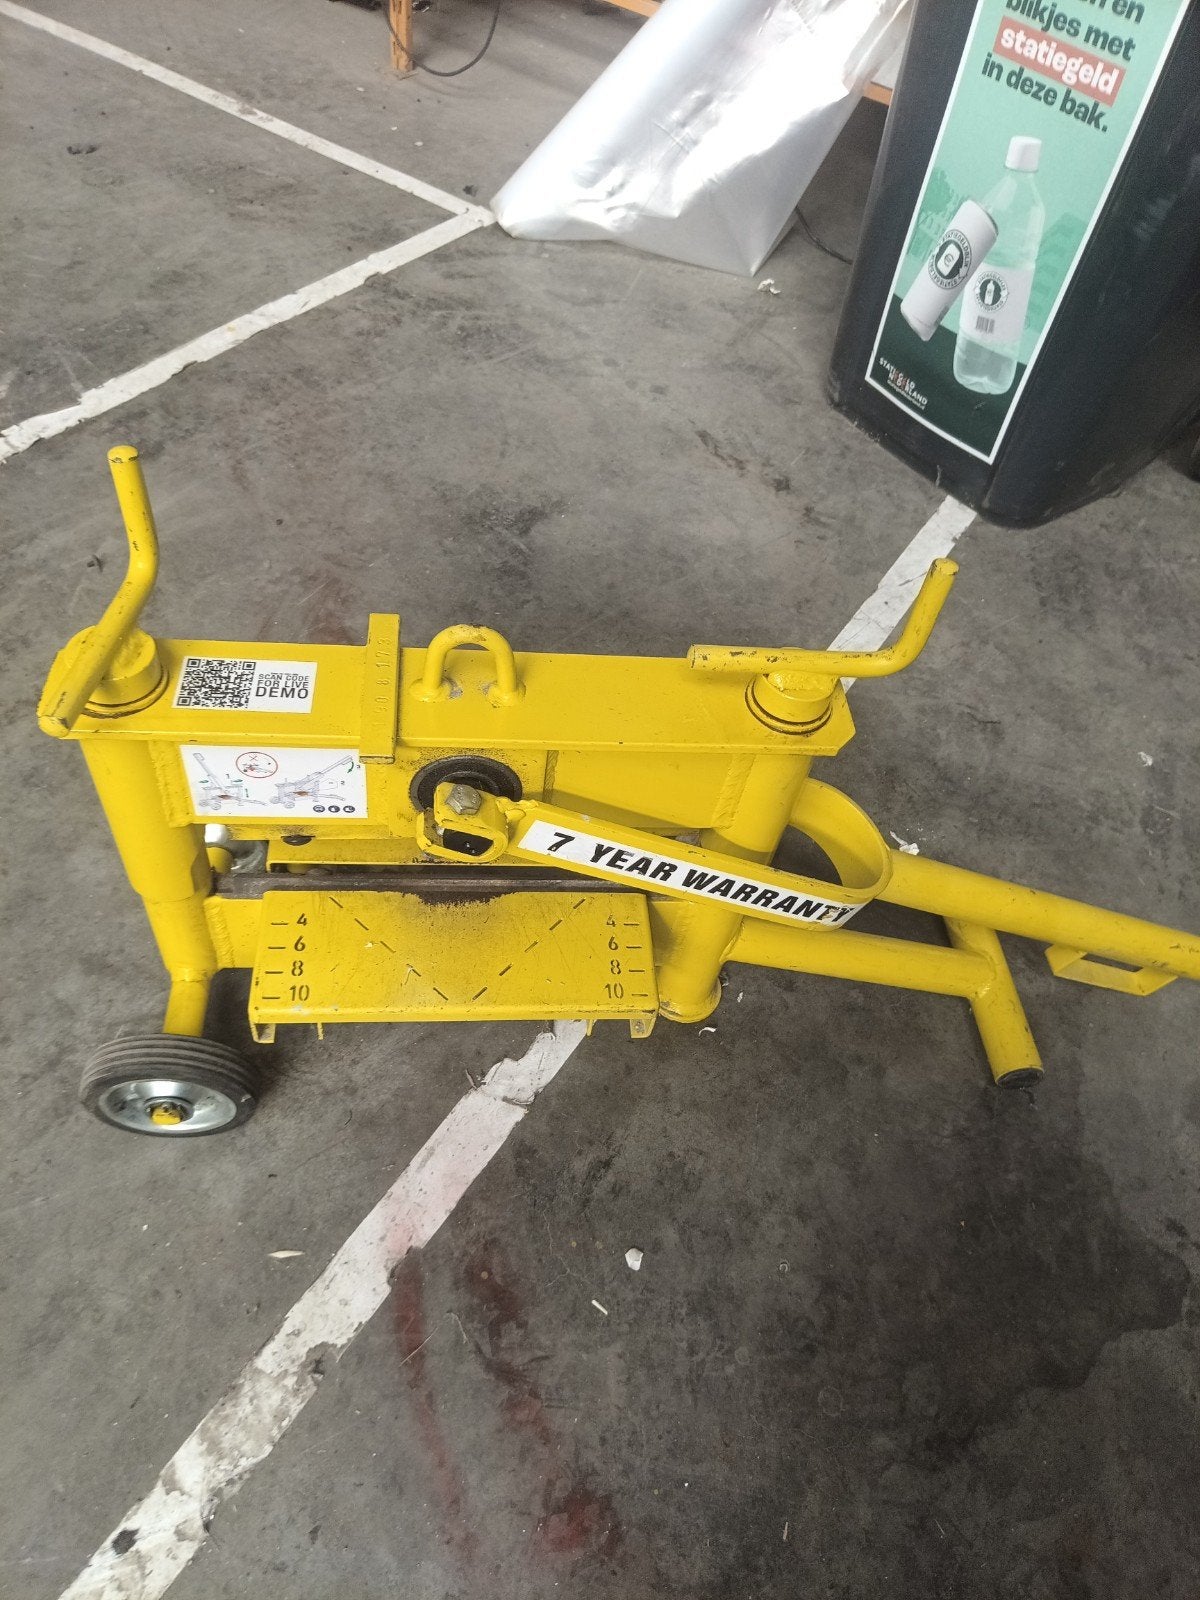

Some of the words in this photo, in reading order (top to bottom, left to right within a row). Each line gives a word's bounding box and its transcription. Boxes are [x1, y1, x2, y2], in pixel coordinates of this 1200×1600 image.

[1111, 0, 1146, 24] en
[1005, 0, 1082, 37] blikjes
[1084, 24, 1136, 62] met
[1000, 27, 1120, 96] statiegeld
[981, 52, 1004, 82] in
[1006, 66, 1058, 106] deze
[1059, 88, 1109, 133] bak.
[255, 686, 309, 699] DEMO
[547, 832, 576, 852] 7
[590, 843, 678, 881] YEAR
[682, 868, 854, 922] WARRANTY
[296, 913, 308, 926] 4
[606, 914, 617, 927] 4
[294, 935, 306, 952] 6
[608, 936, 619, 951] 6
[291, 960, 304, 976] 8
[610, 959, 622, 975] 8
[289, 985, 310, 1001] 10
[603, 983, 624, 999] 10
